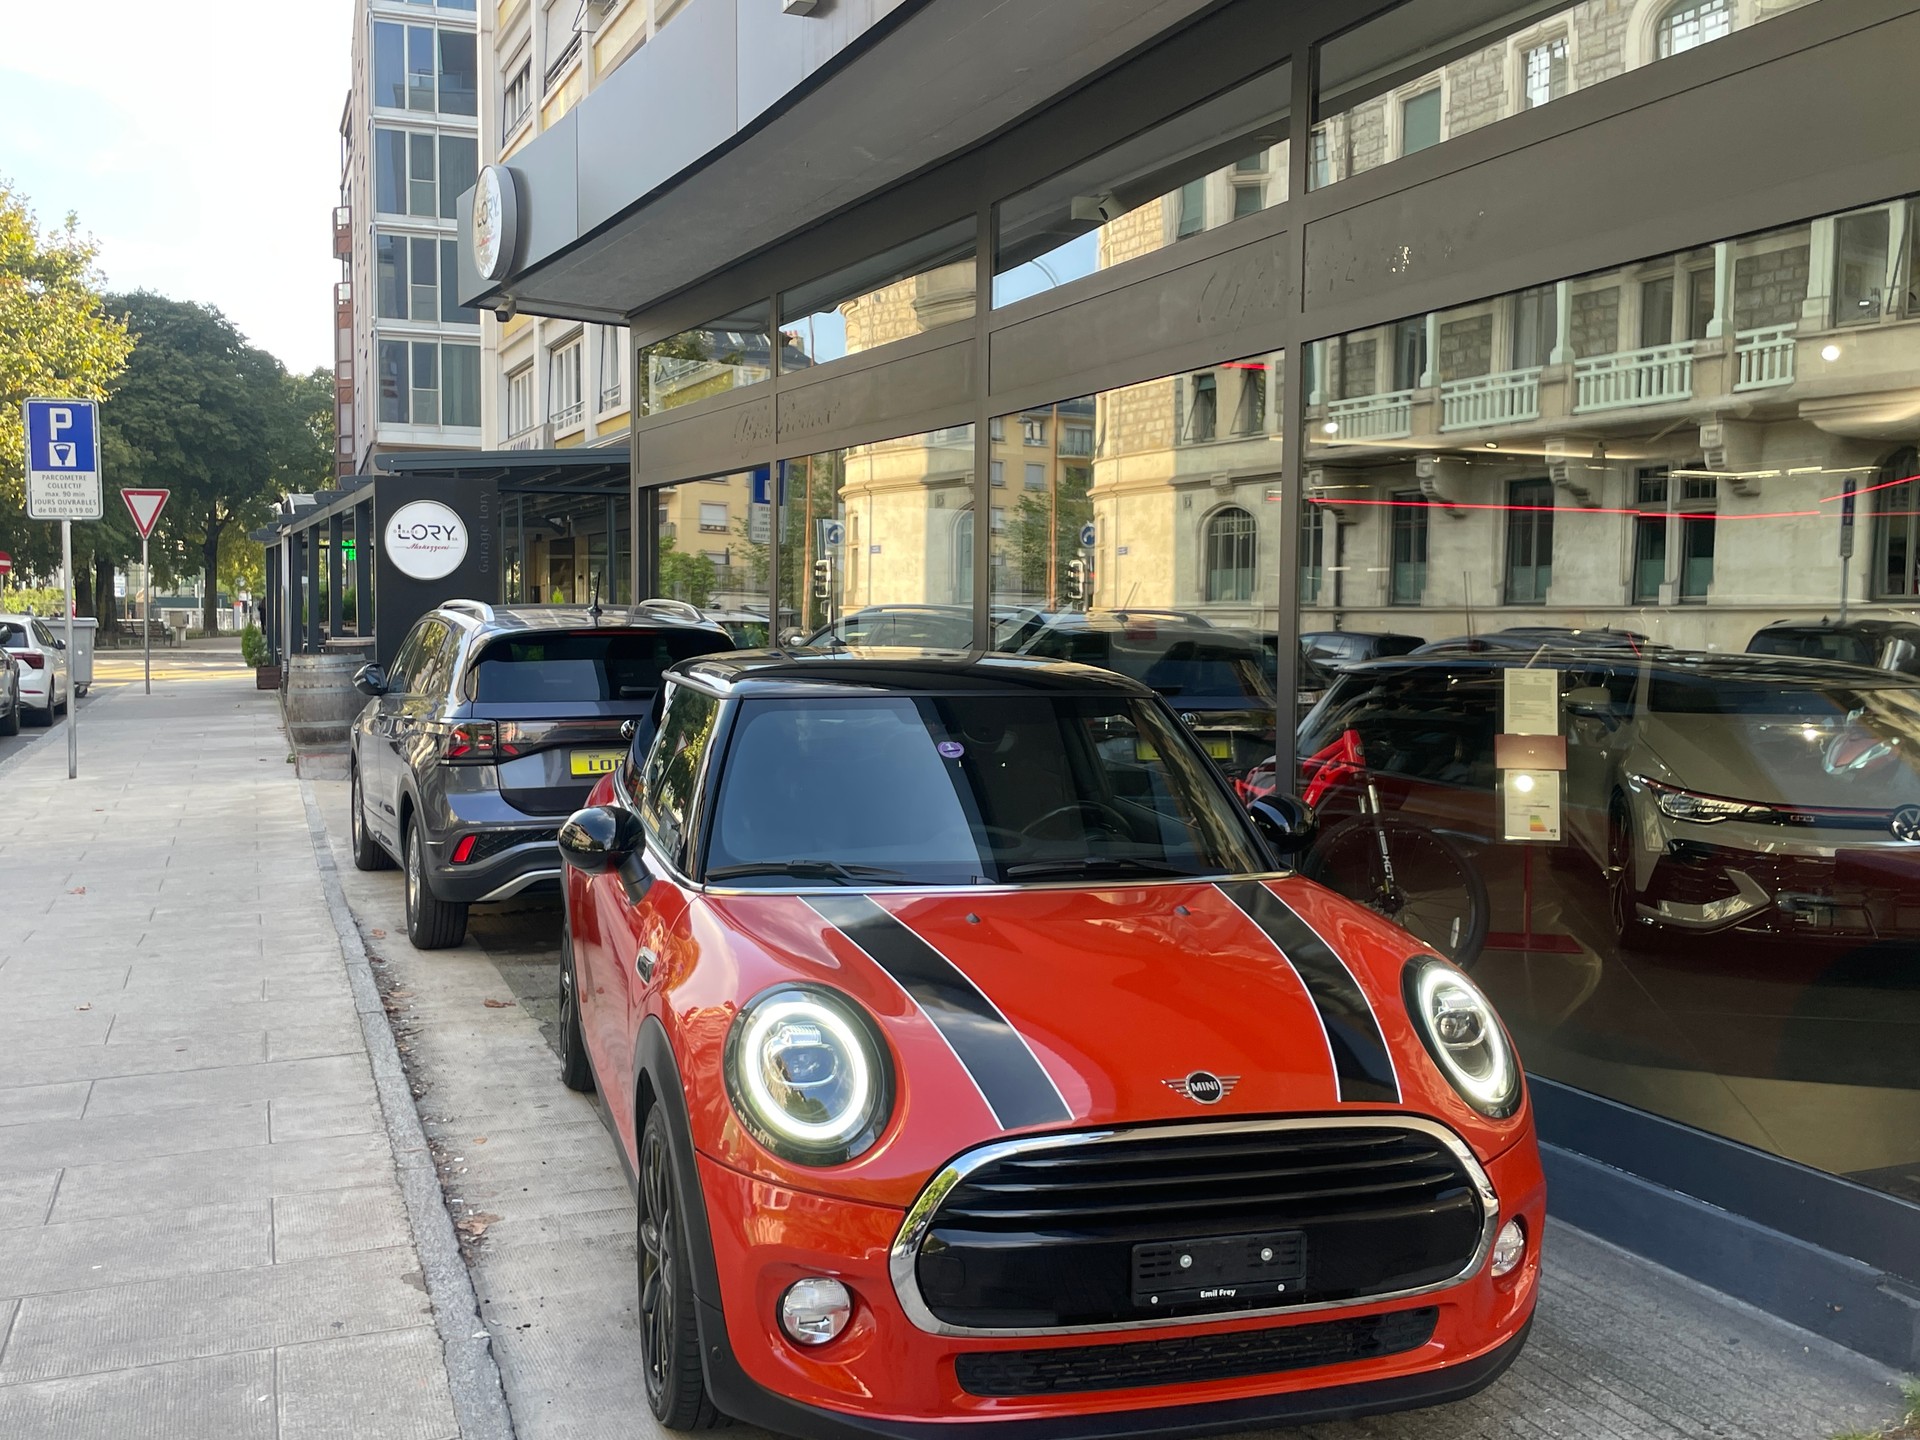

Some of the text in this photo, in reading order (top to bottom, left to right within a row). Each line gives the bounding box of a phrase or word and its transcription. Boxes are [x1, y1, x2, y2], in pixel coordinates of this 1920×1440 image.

[49, 408, 72, 441] P
[62, 490, 72, 498] 90
[34, 498, 97, 506] JOURS OUVRABLES
[38, 506, 47, 514] de
[398, 524, 456, 541] LORY
[1190, 1080, 1219, 1092] MINI
[1200, 1288, 1237, 1298] Emil Frey
